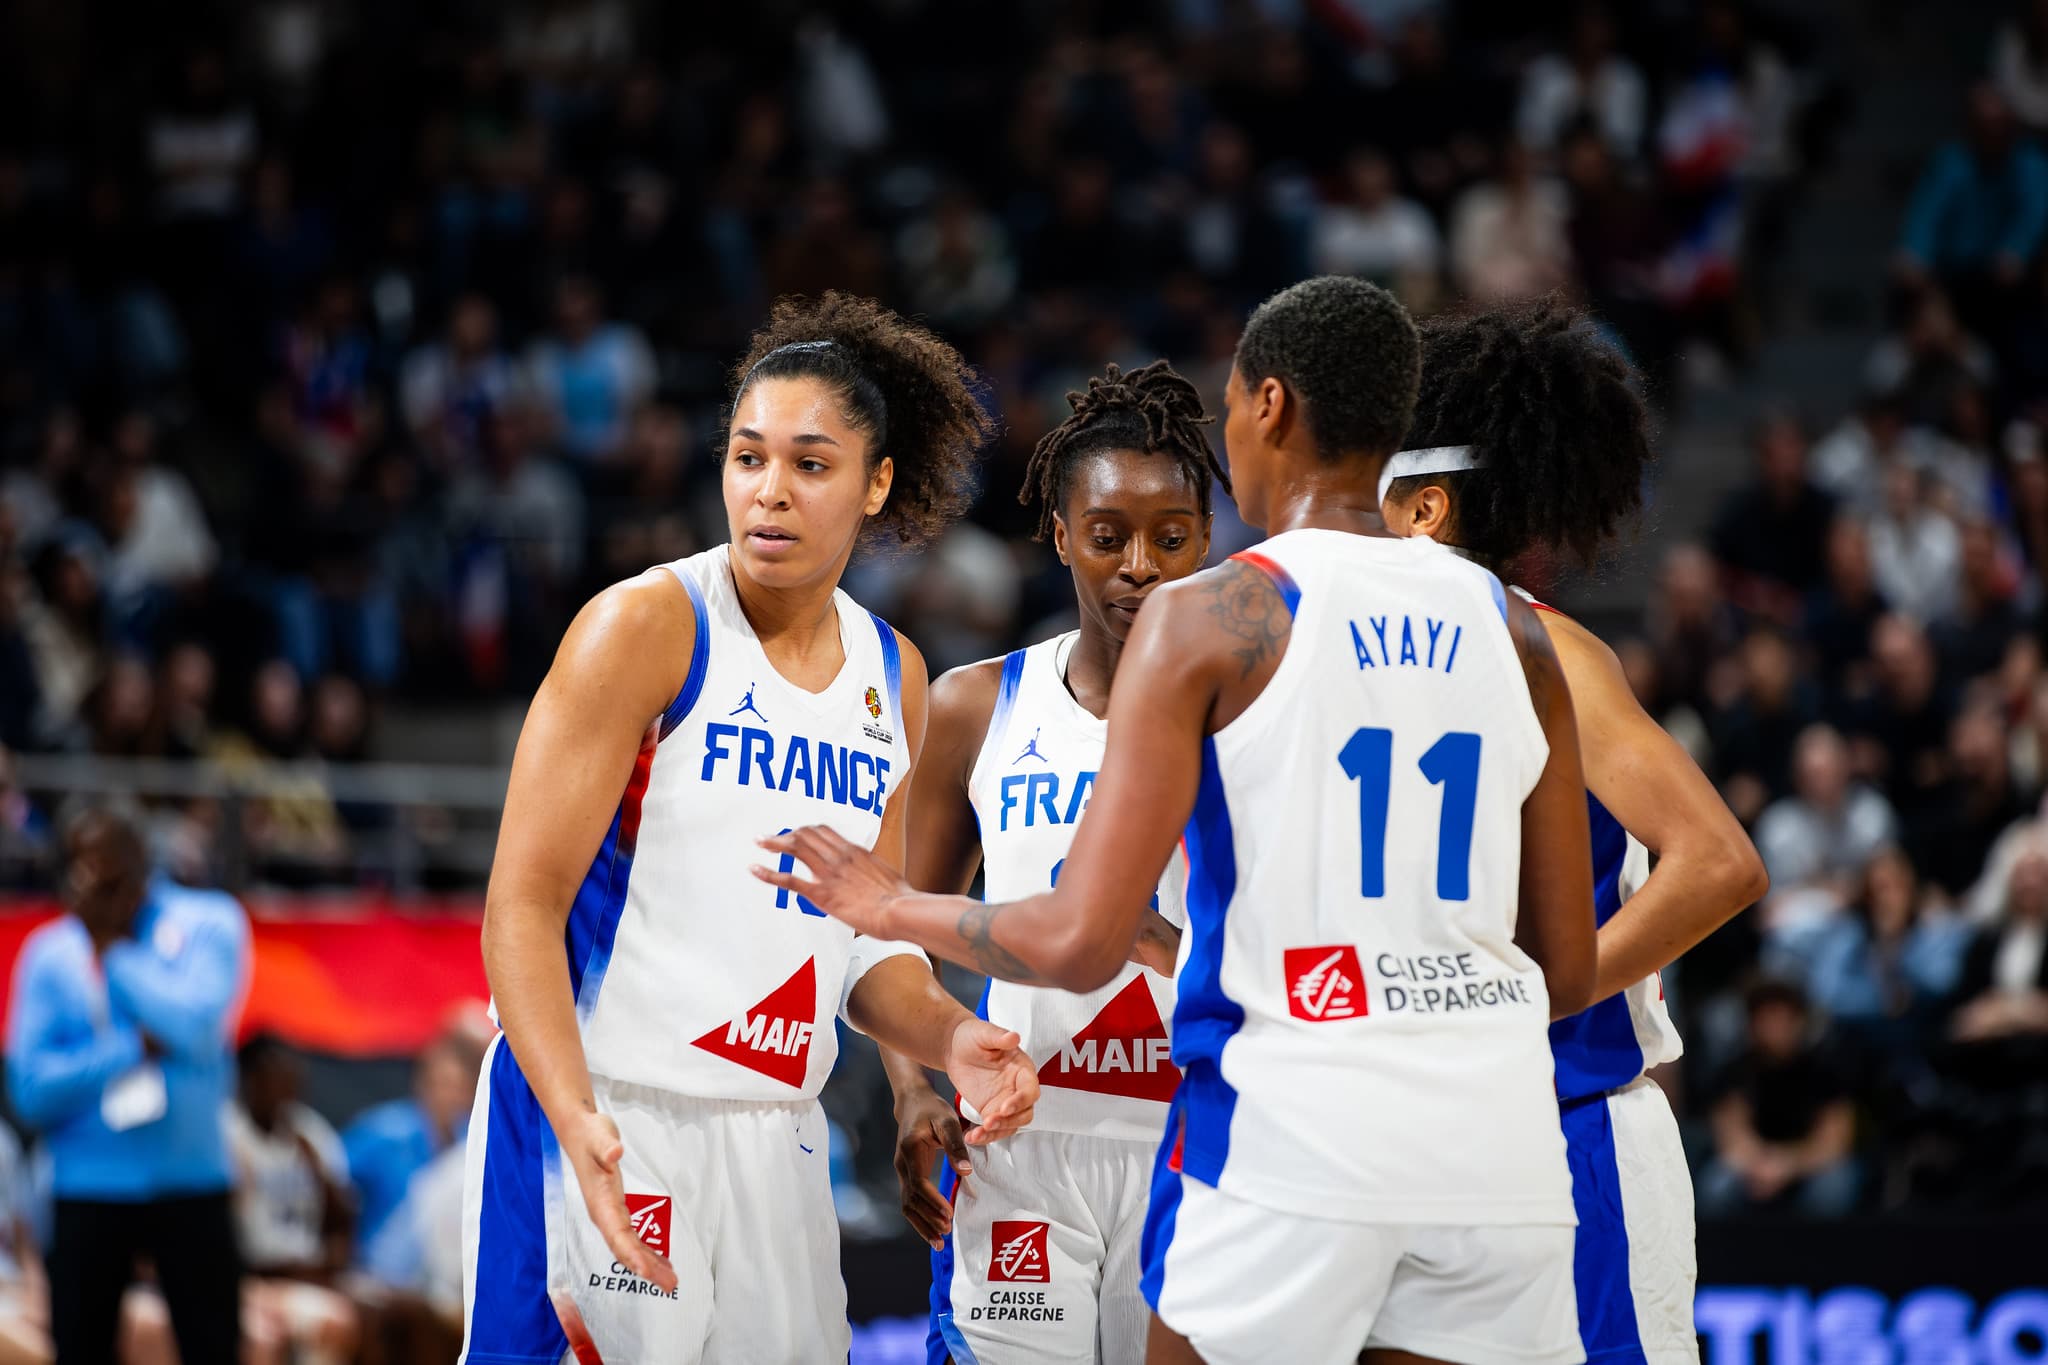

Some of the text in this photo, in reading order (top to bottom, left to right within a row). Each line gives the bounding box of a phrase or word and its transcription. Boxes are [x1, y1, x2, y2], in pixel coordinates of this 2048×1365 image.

[1349, 615, 1462, 673] AYAYI
[701, 722, 890, 818] FRANCE
[1338, 727, 1481, 901] 11
[776, 828, 828, 917] 1
[725, 1014, 814, 1057] MAIF
[1060, 1038, 1171, 1073] MAIF
[970, 1307, 1064, 1321] D'EPARGNE
[990, 1291, 1045, 1304] CAISSE
